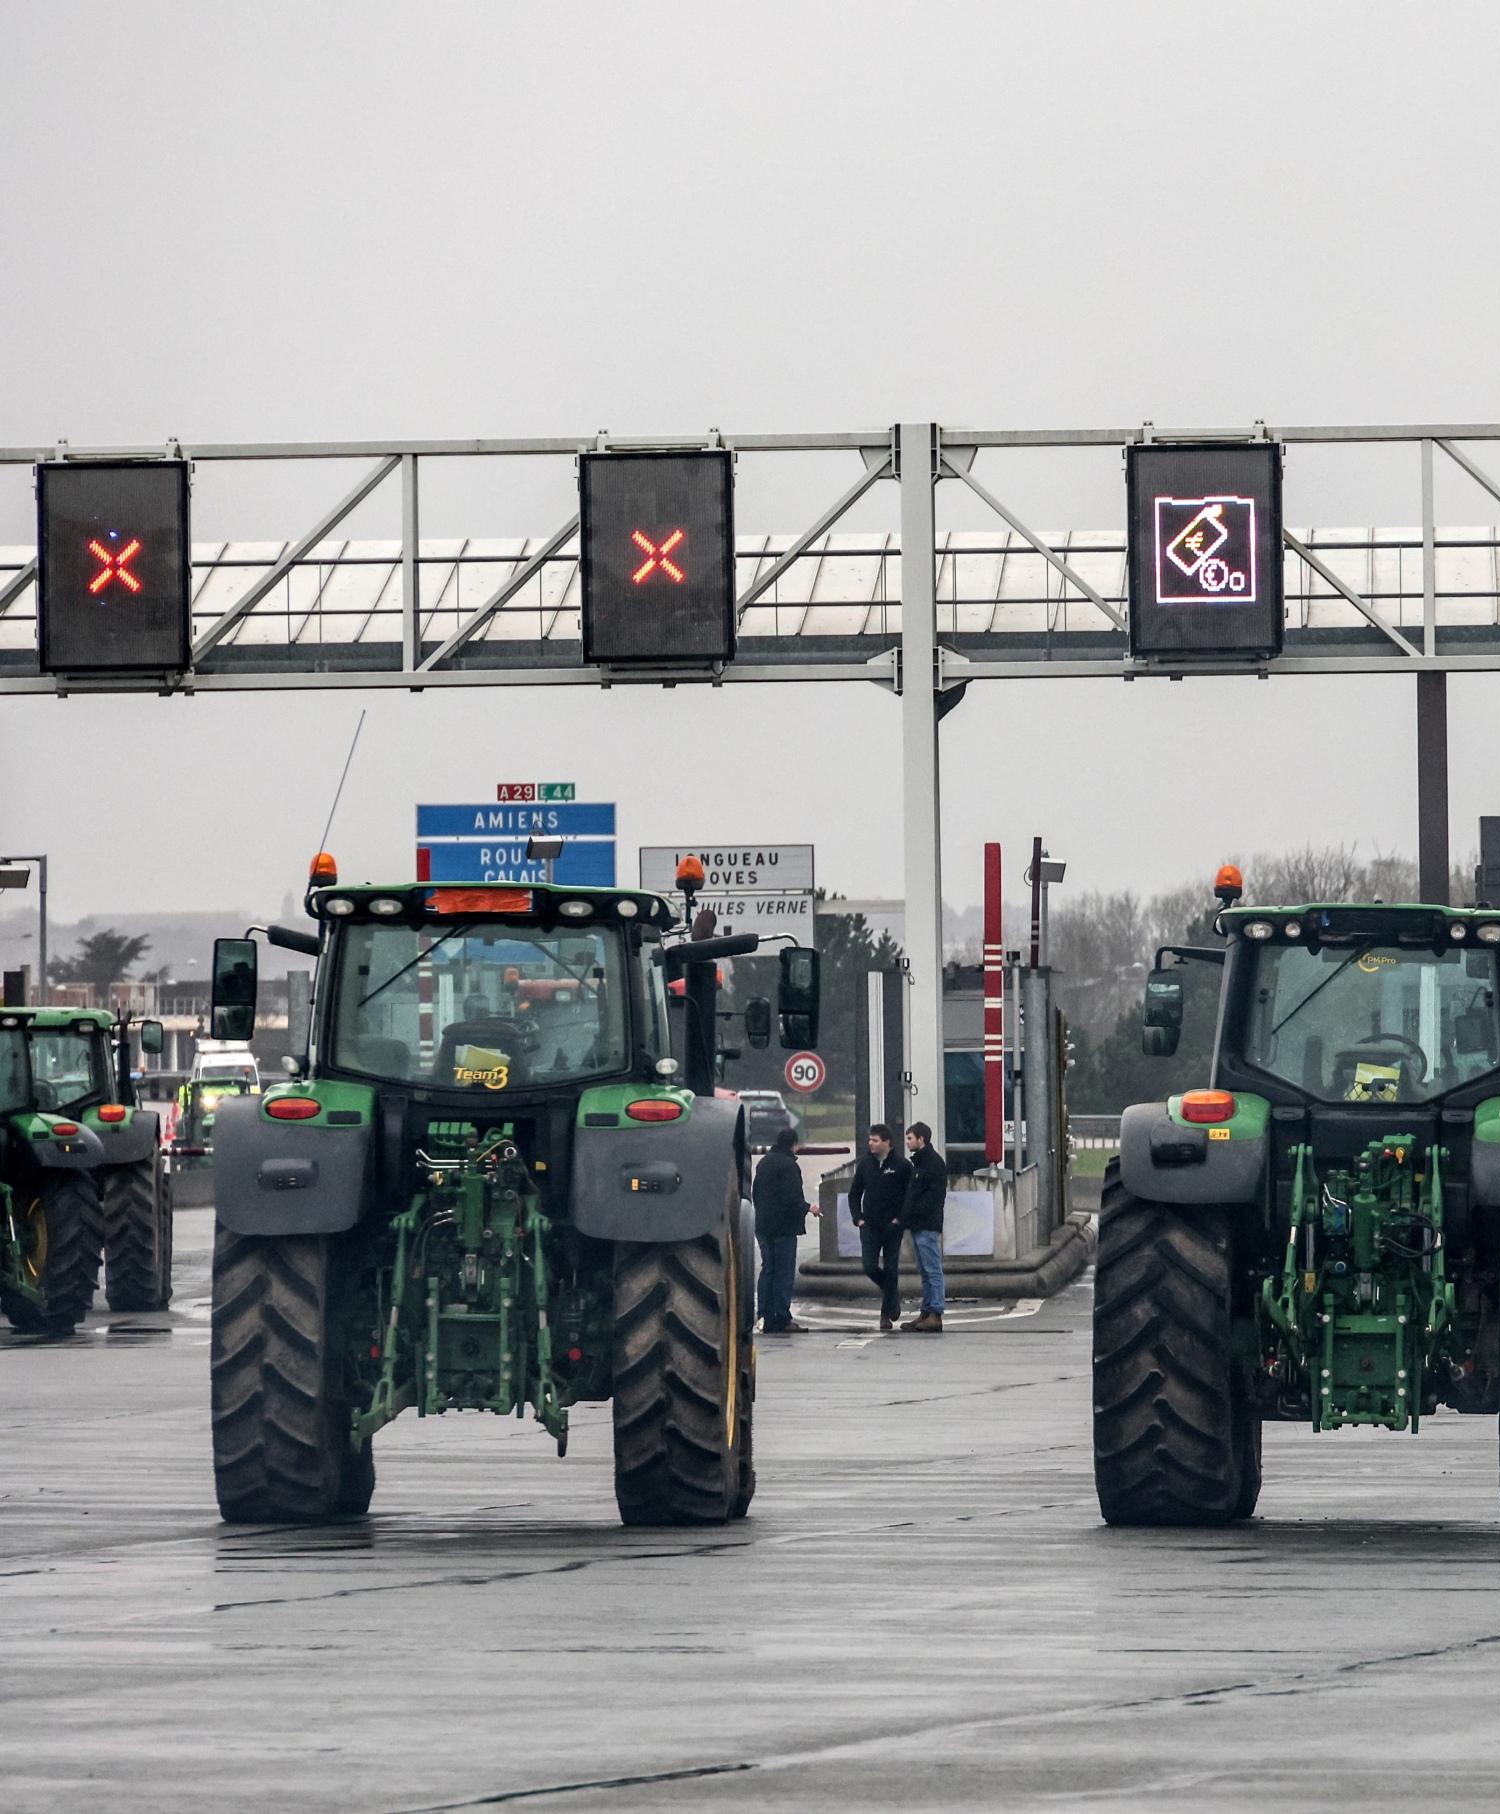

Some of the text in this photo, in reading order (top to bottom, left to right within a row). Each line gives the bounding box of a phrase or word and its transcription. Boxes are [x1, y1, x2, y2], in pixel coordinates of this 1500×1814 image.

[500, 785, 533, 799] A 29
[539, 784, 573, 798] E 44
[474, 811, 558, 829] AMIENS
[756, 900, 808, 915] VERNE
[453, 1066, 509, 1090] Team3
[793, 1065, 817, 1081] 90
